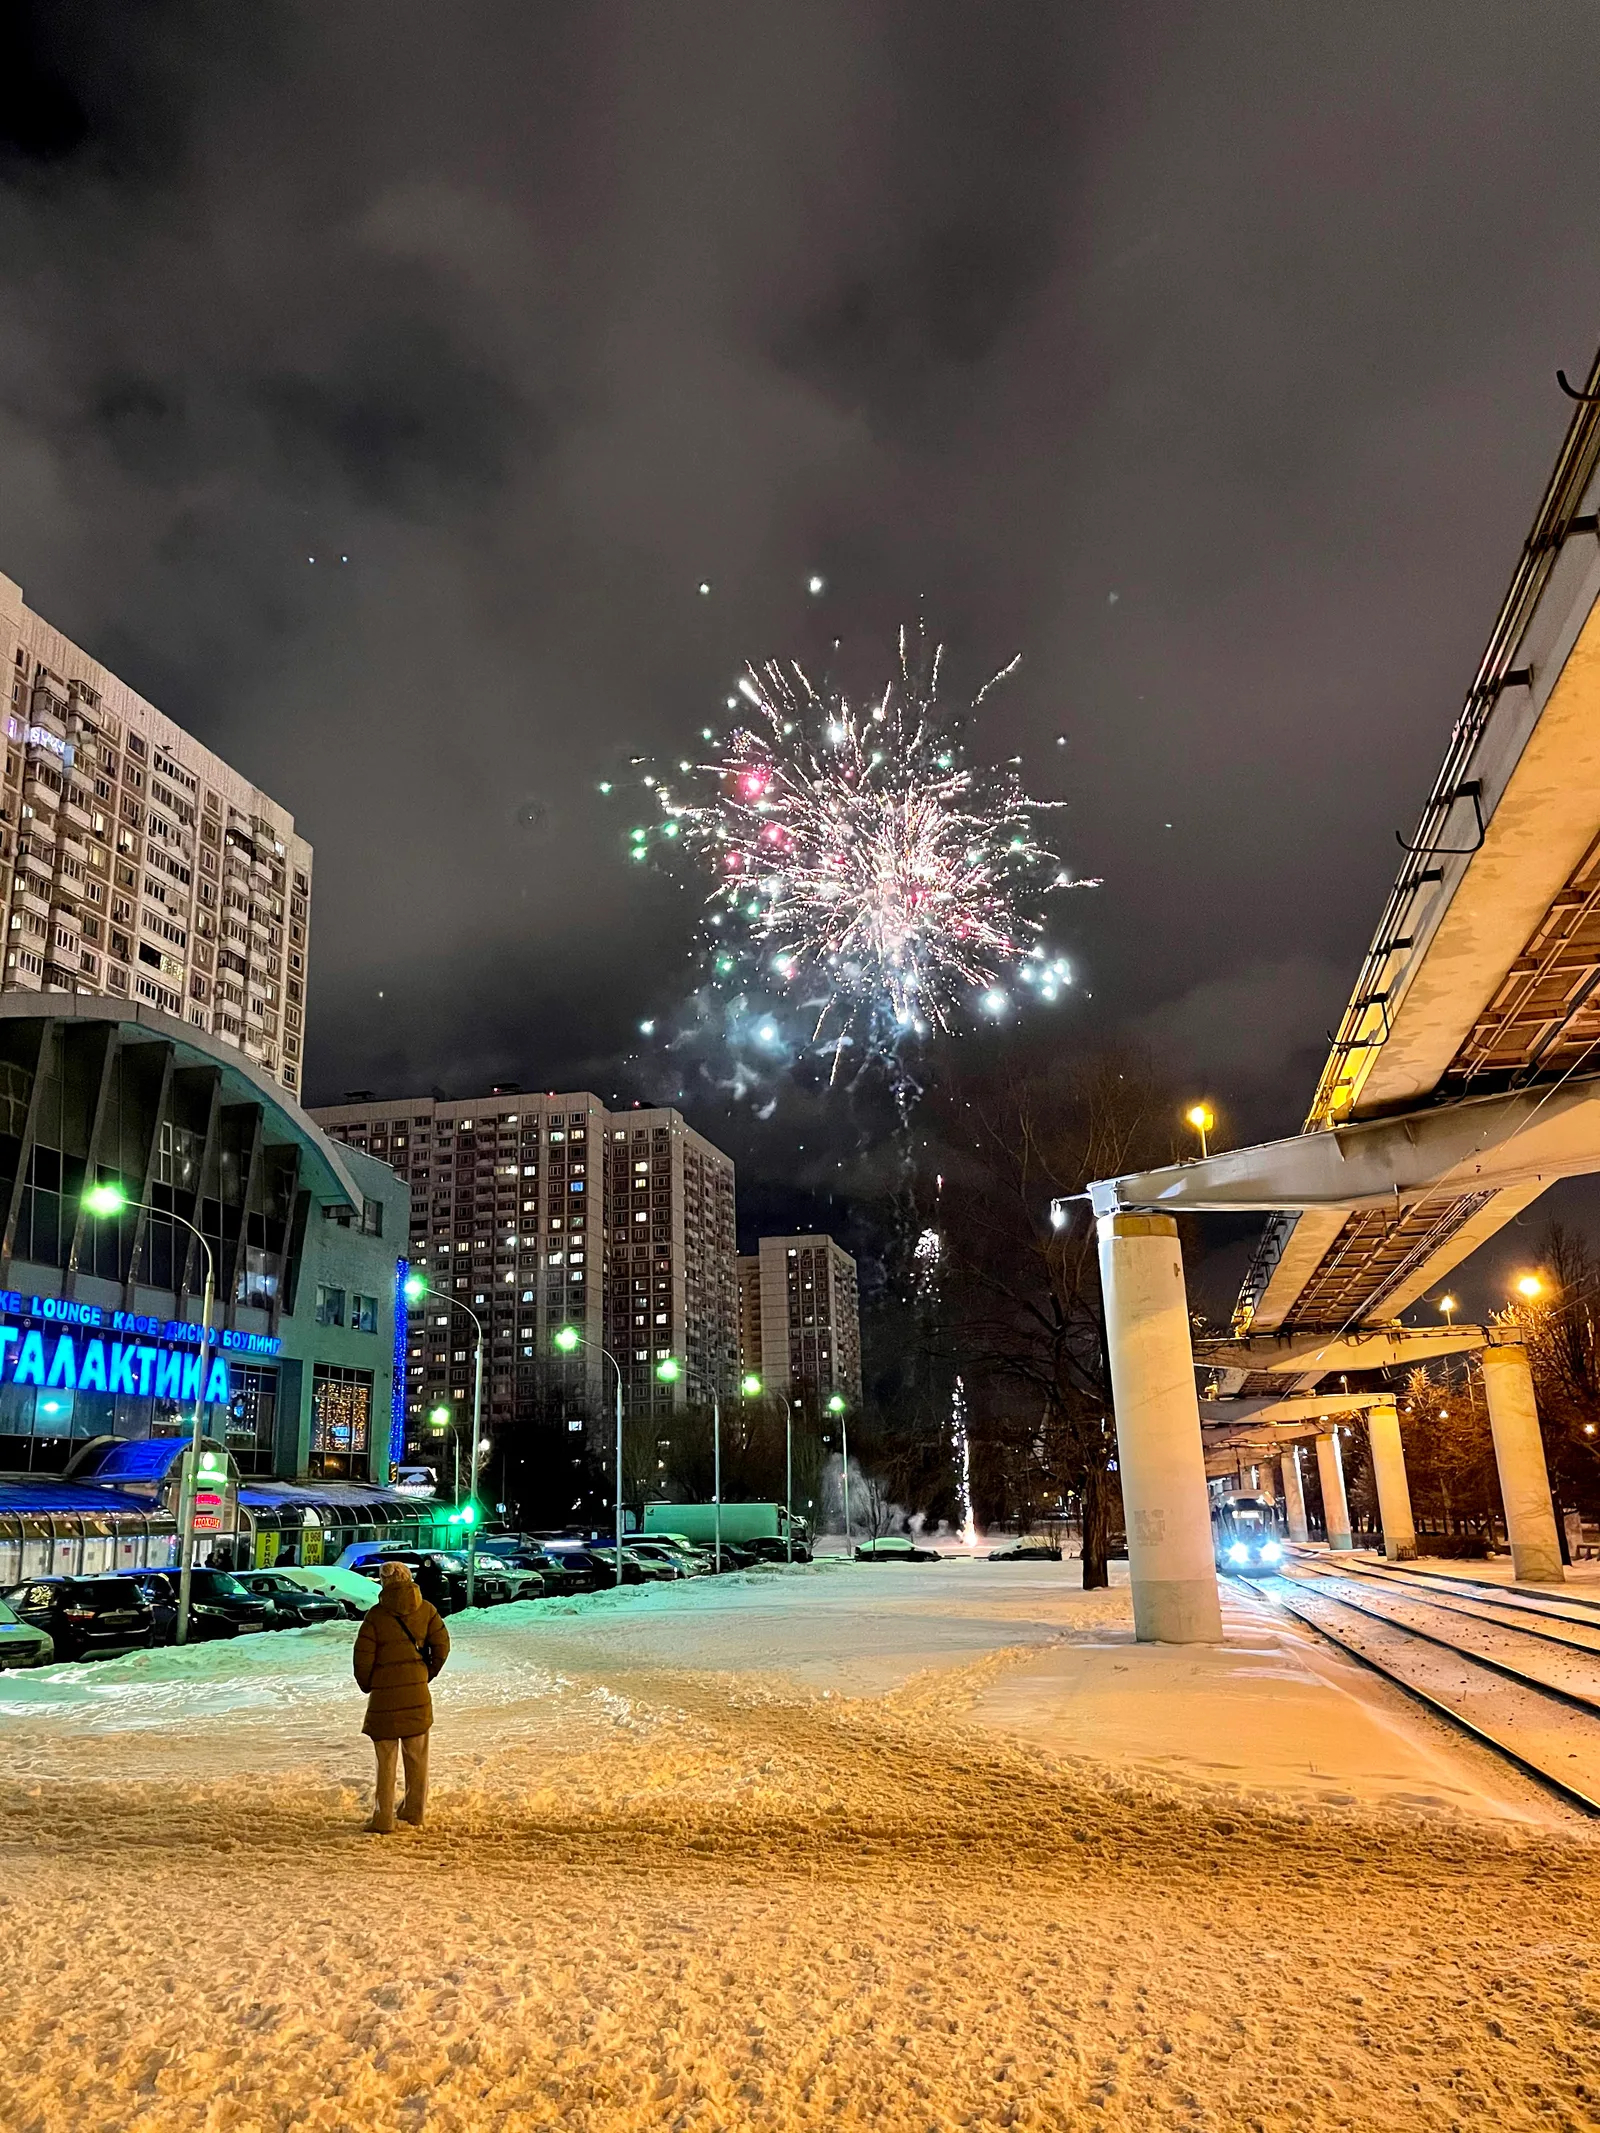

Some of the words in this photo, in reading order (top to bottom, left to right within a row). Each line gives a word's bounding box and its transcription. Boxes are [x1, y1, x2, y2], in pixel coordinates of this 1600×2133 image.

[31, 1296, 100, 1325] LOUNGE
[113, 1311, 158, 1335] КАФЕ
[222, 1329, 281, 1354] БОУЛИНГ
[263, 1532, 272, 1568] АРЕНД
